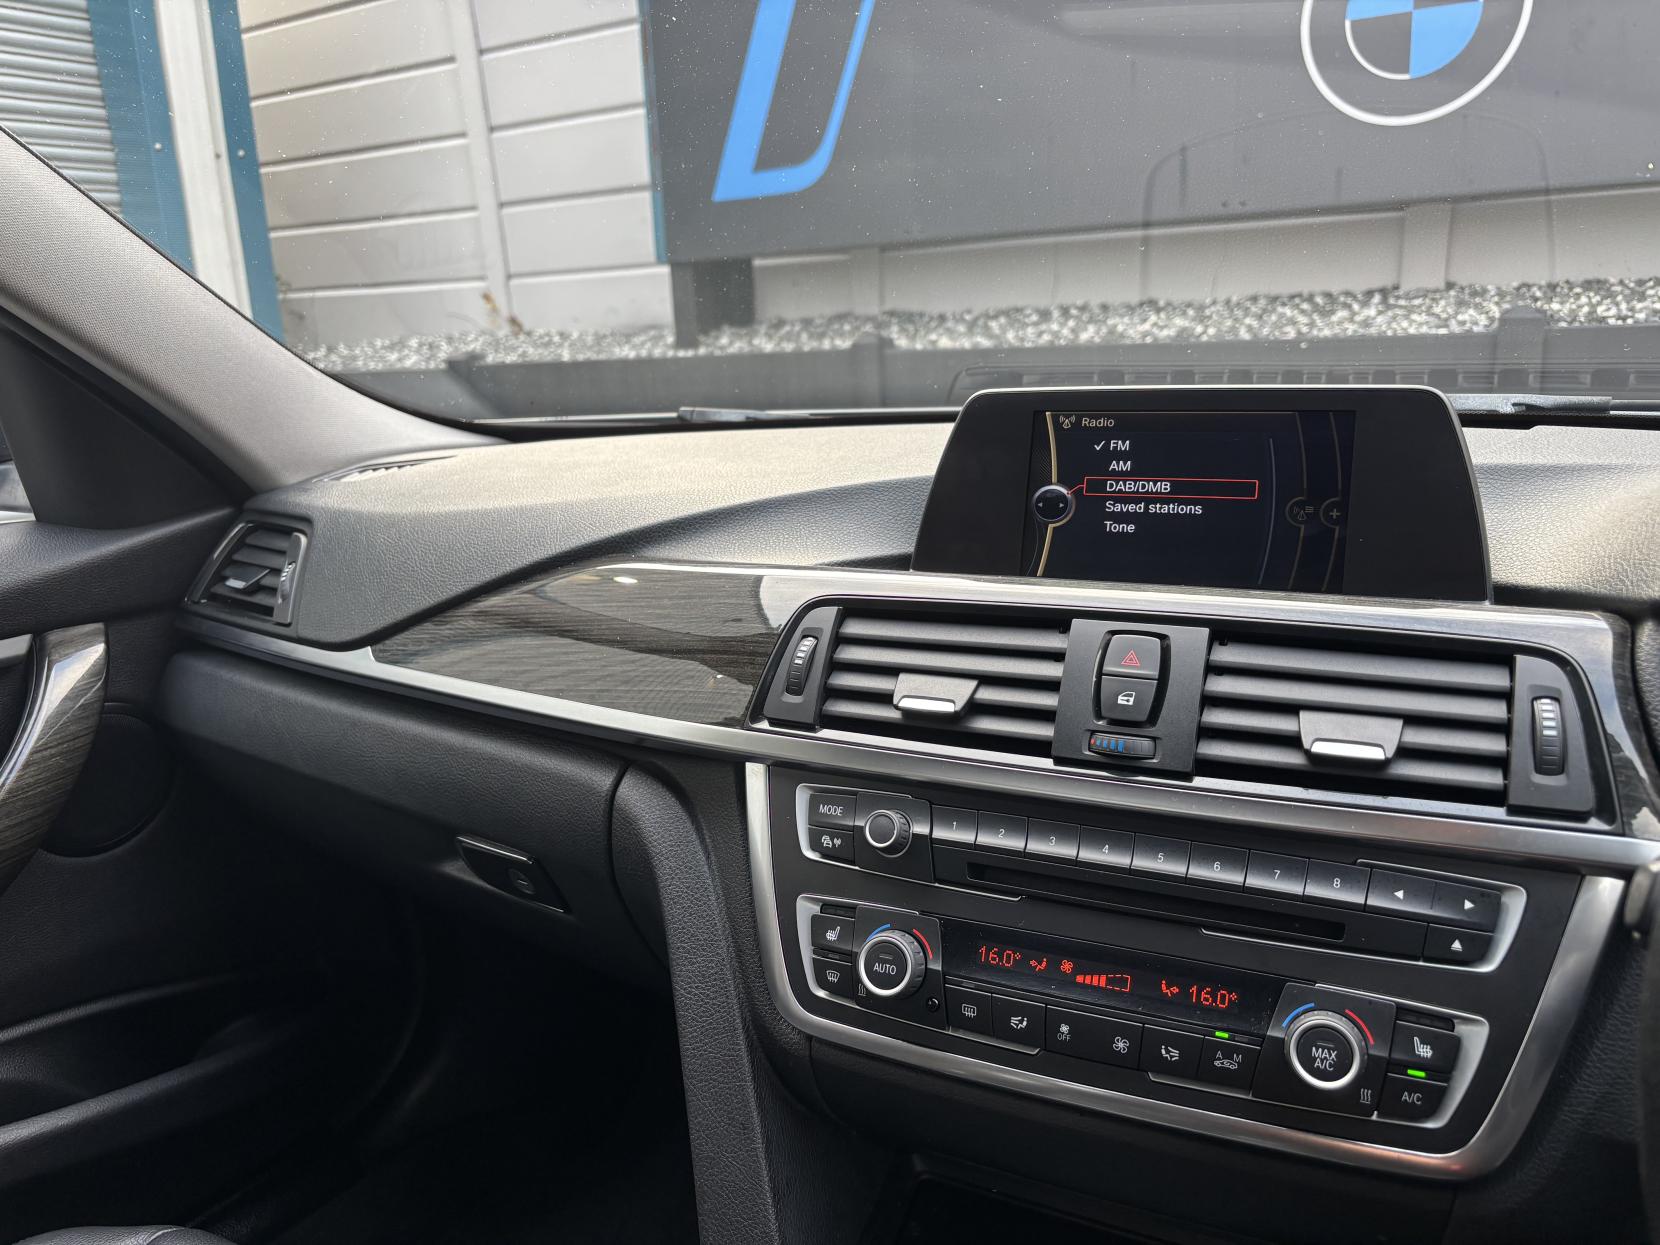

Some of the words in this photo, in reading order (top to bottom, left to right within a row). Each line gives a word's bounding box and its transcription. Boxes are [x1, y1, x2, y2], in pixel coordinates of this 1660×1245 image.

[1081, 417, 1115, 428] Radio
[1110, 440, 1130, 451] FM
[1109, 460, 1131, 472] AM
[1106, 481, 1171, 493] DAB/DMB
[1105, 500, 1144, 513] Saved
[1148, 502, 1203, 515] stations
[1104, 521, 1136, 533] Tone
[818, 803, 844, 817] MODE
[951, 820, 958, 831] 1
[998, 828, 1005, 838] 2
[1049, 836, 1056, 846] 3
[1102, 844, 1109, 854] 4
[1157, 852, 1165, 863] 5
[1213, 861, 1221, 872] 6
[1273, 869, 1281, 880] 7
[1333, 877, 1341, 889] 8
[873, 961, 897, 975] AUTO
[1057, 1032, 1071, 1043] OFF
[1215, 1050, 1223, 1060] A
[1233, 1053, 1242, 1063] M
[1312, 1047, 1338, 1062] MAX
[1314, 1059, 1335, 1071] A/C
[1401, 1091, 1423, 1105] A/C
